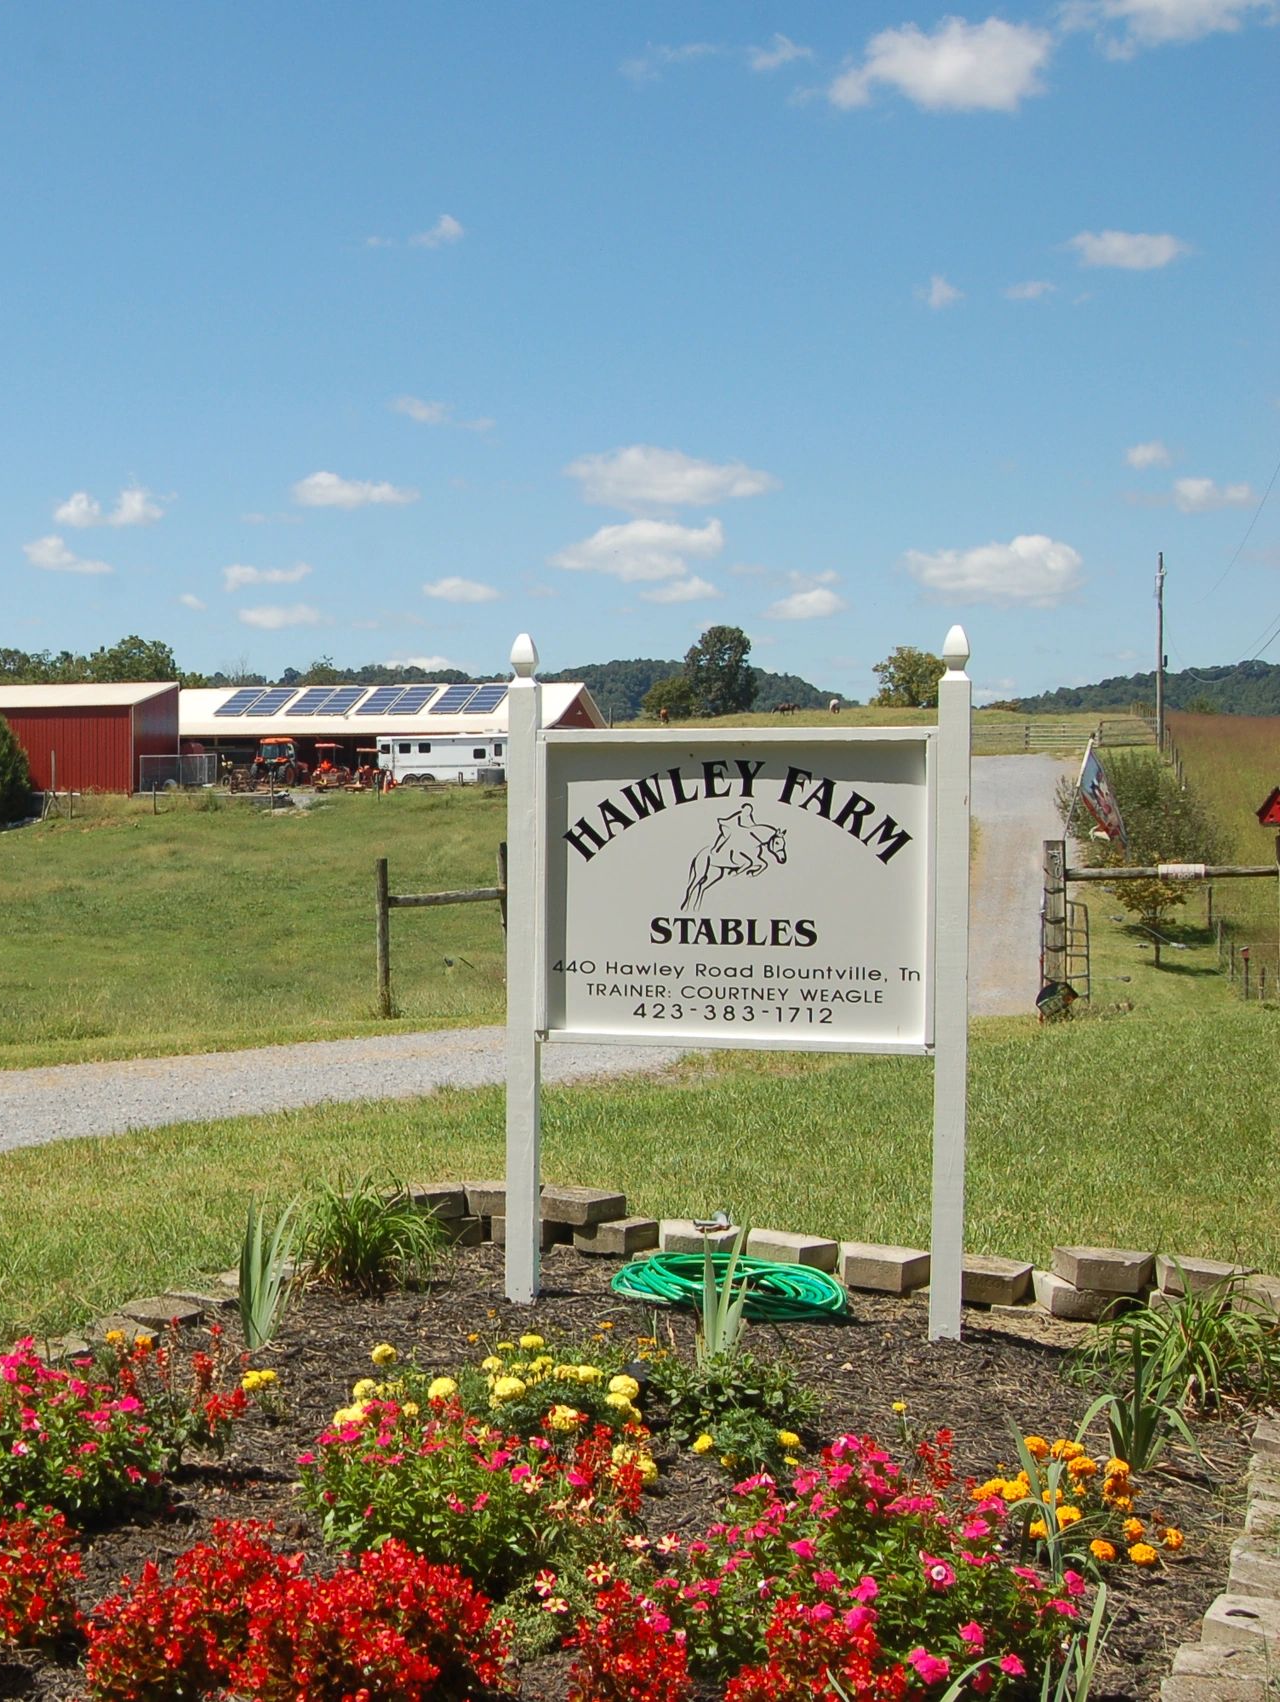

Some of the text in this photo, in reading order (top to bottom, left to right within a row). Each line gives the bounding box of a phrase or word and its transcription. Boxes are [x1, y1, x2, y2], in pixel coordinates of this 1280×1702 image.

[562, 759, 914, 866] HAWLEY FARM
[649, 916, 818, 948] STABLES
[552, 960, 921, 983] 440 Hawley Road Blountville, Tn
[586, 982, 884, 1004] TRAINER: COURTNEY WEAGLE
[632, 1002, 833, 1024] 423-383-1712
